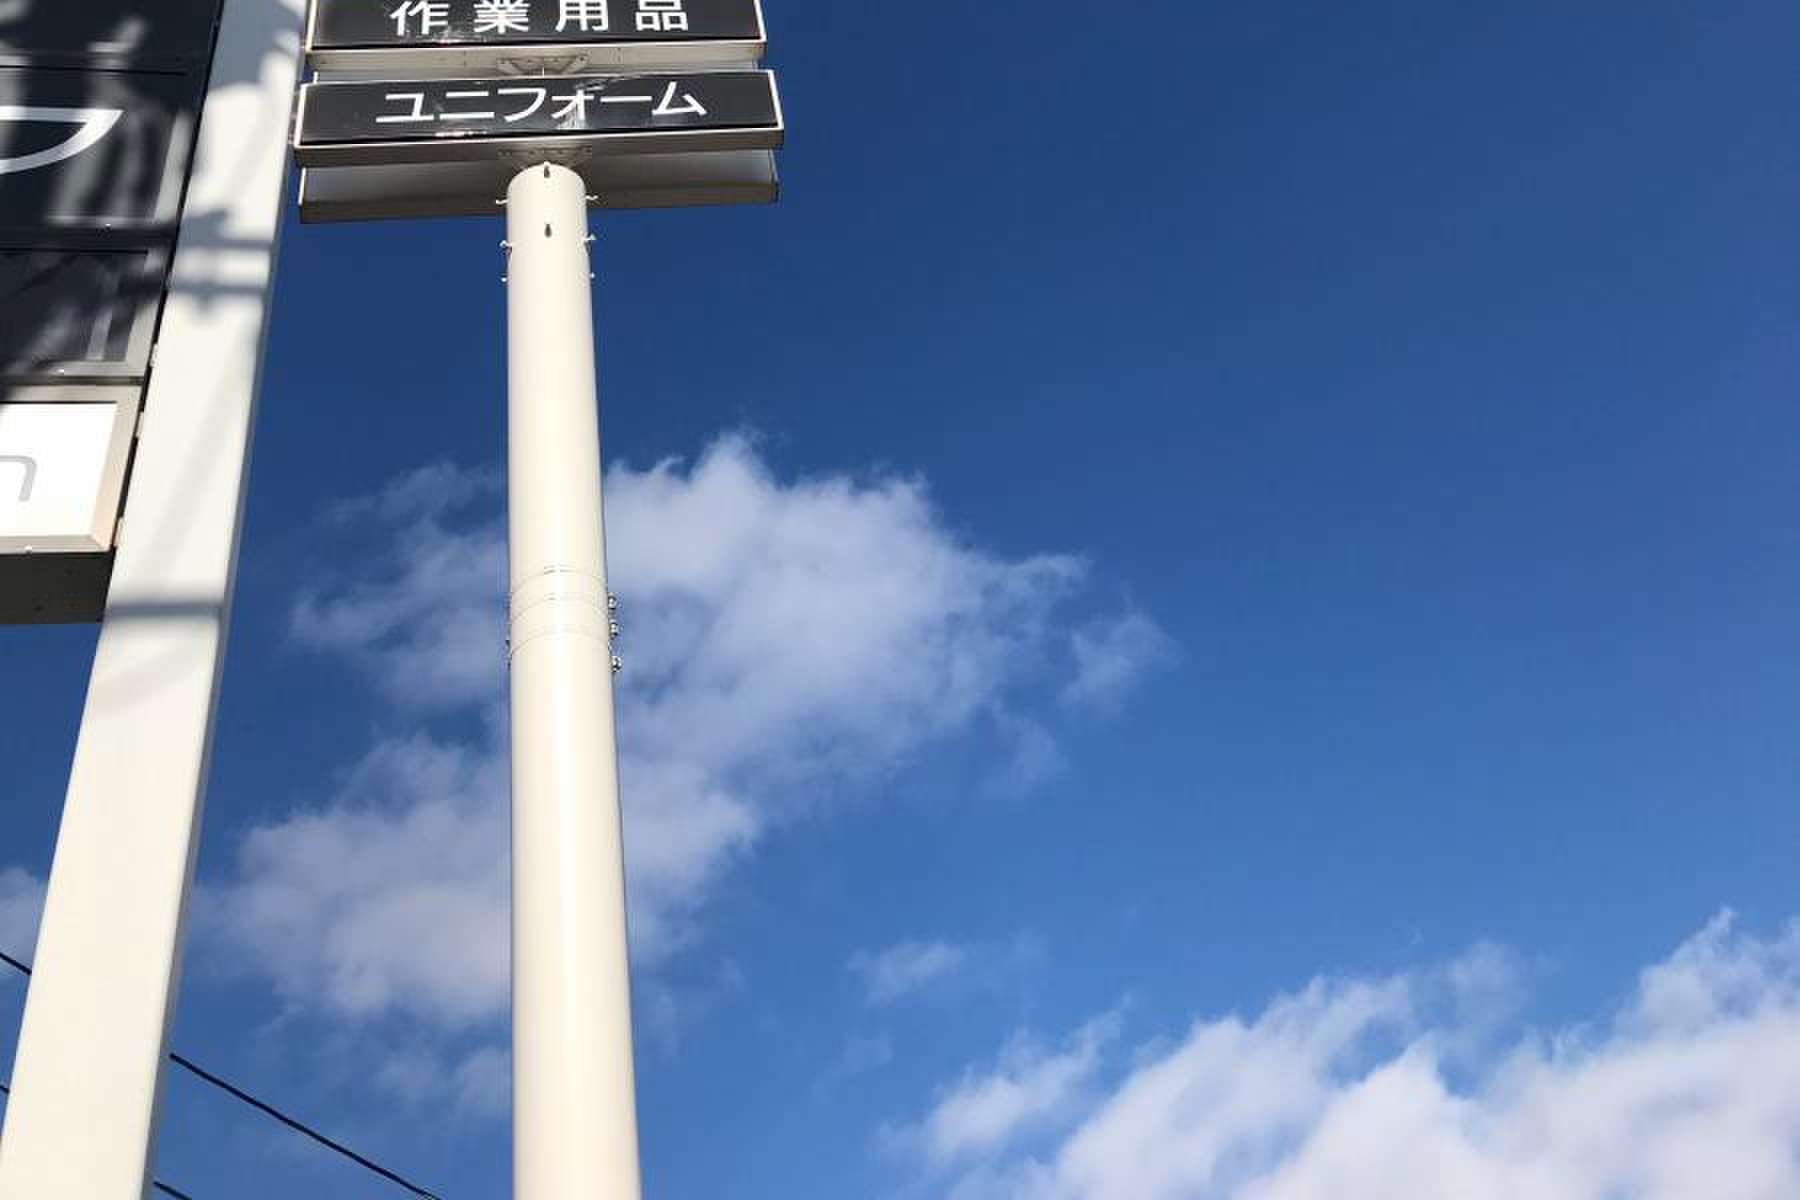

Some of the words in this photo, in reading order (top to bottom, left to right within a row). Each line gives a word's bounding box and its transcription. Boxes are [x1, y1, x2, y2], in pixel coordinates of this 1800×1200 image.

[375, 81, 708, 124] ユニフォーム
